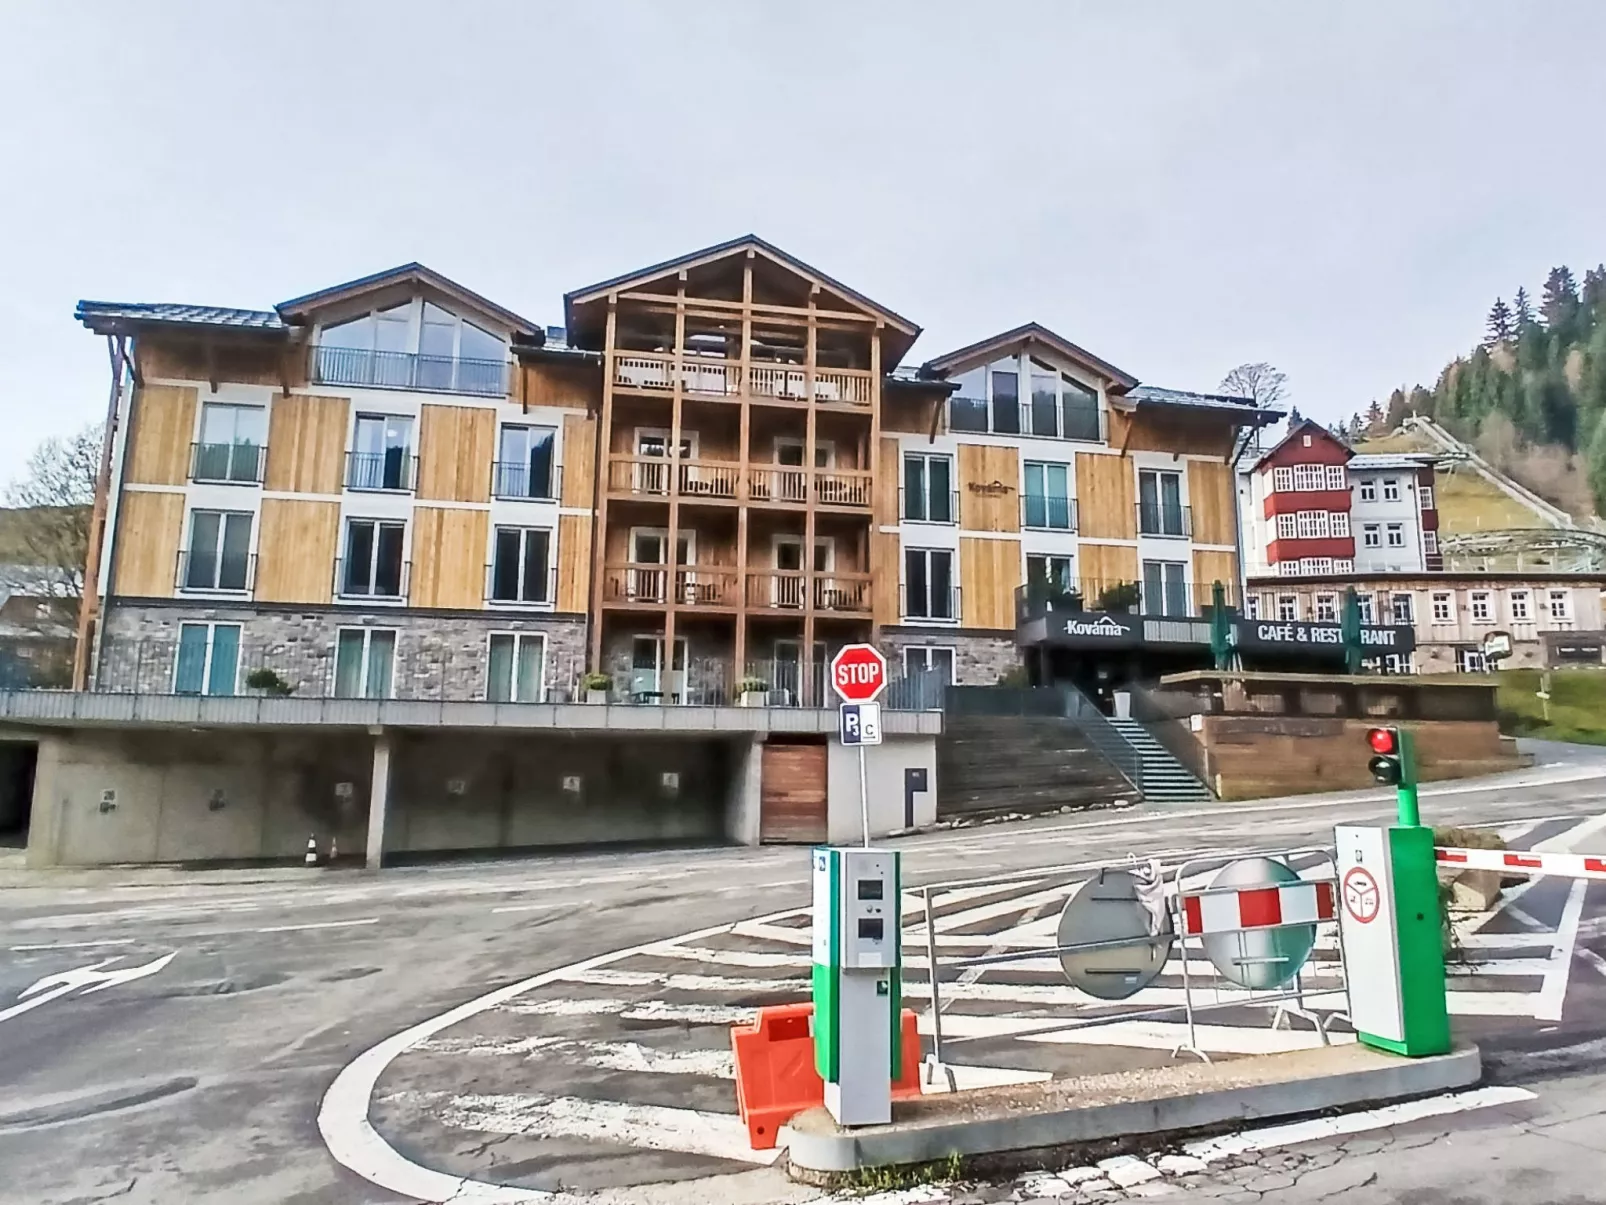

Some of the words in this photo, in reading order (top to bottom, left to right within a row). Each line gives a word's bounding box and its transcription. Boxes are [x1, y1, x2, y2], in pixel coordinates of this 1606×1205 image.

[1066, 618, 1123, 636] Kovárna
[1258, 623, 1294, 642] CAFÉ
[1296, 627, 1308, 642] &
[1311, 627, 1396, 646] RESTRANT
[838, 663, 879, 685] STOP
[865, 724, 874, 735] C
